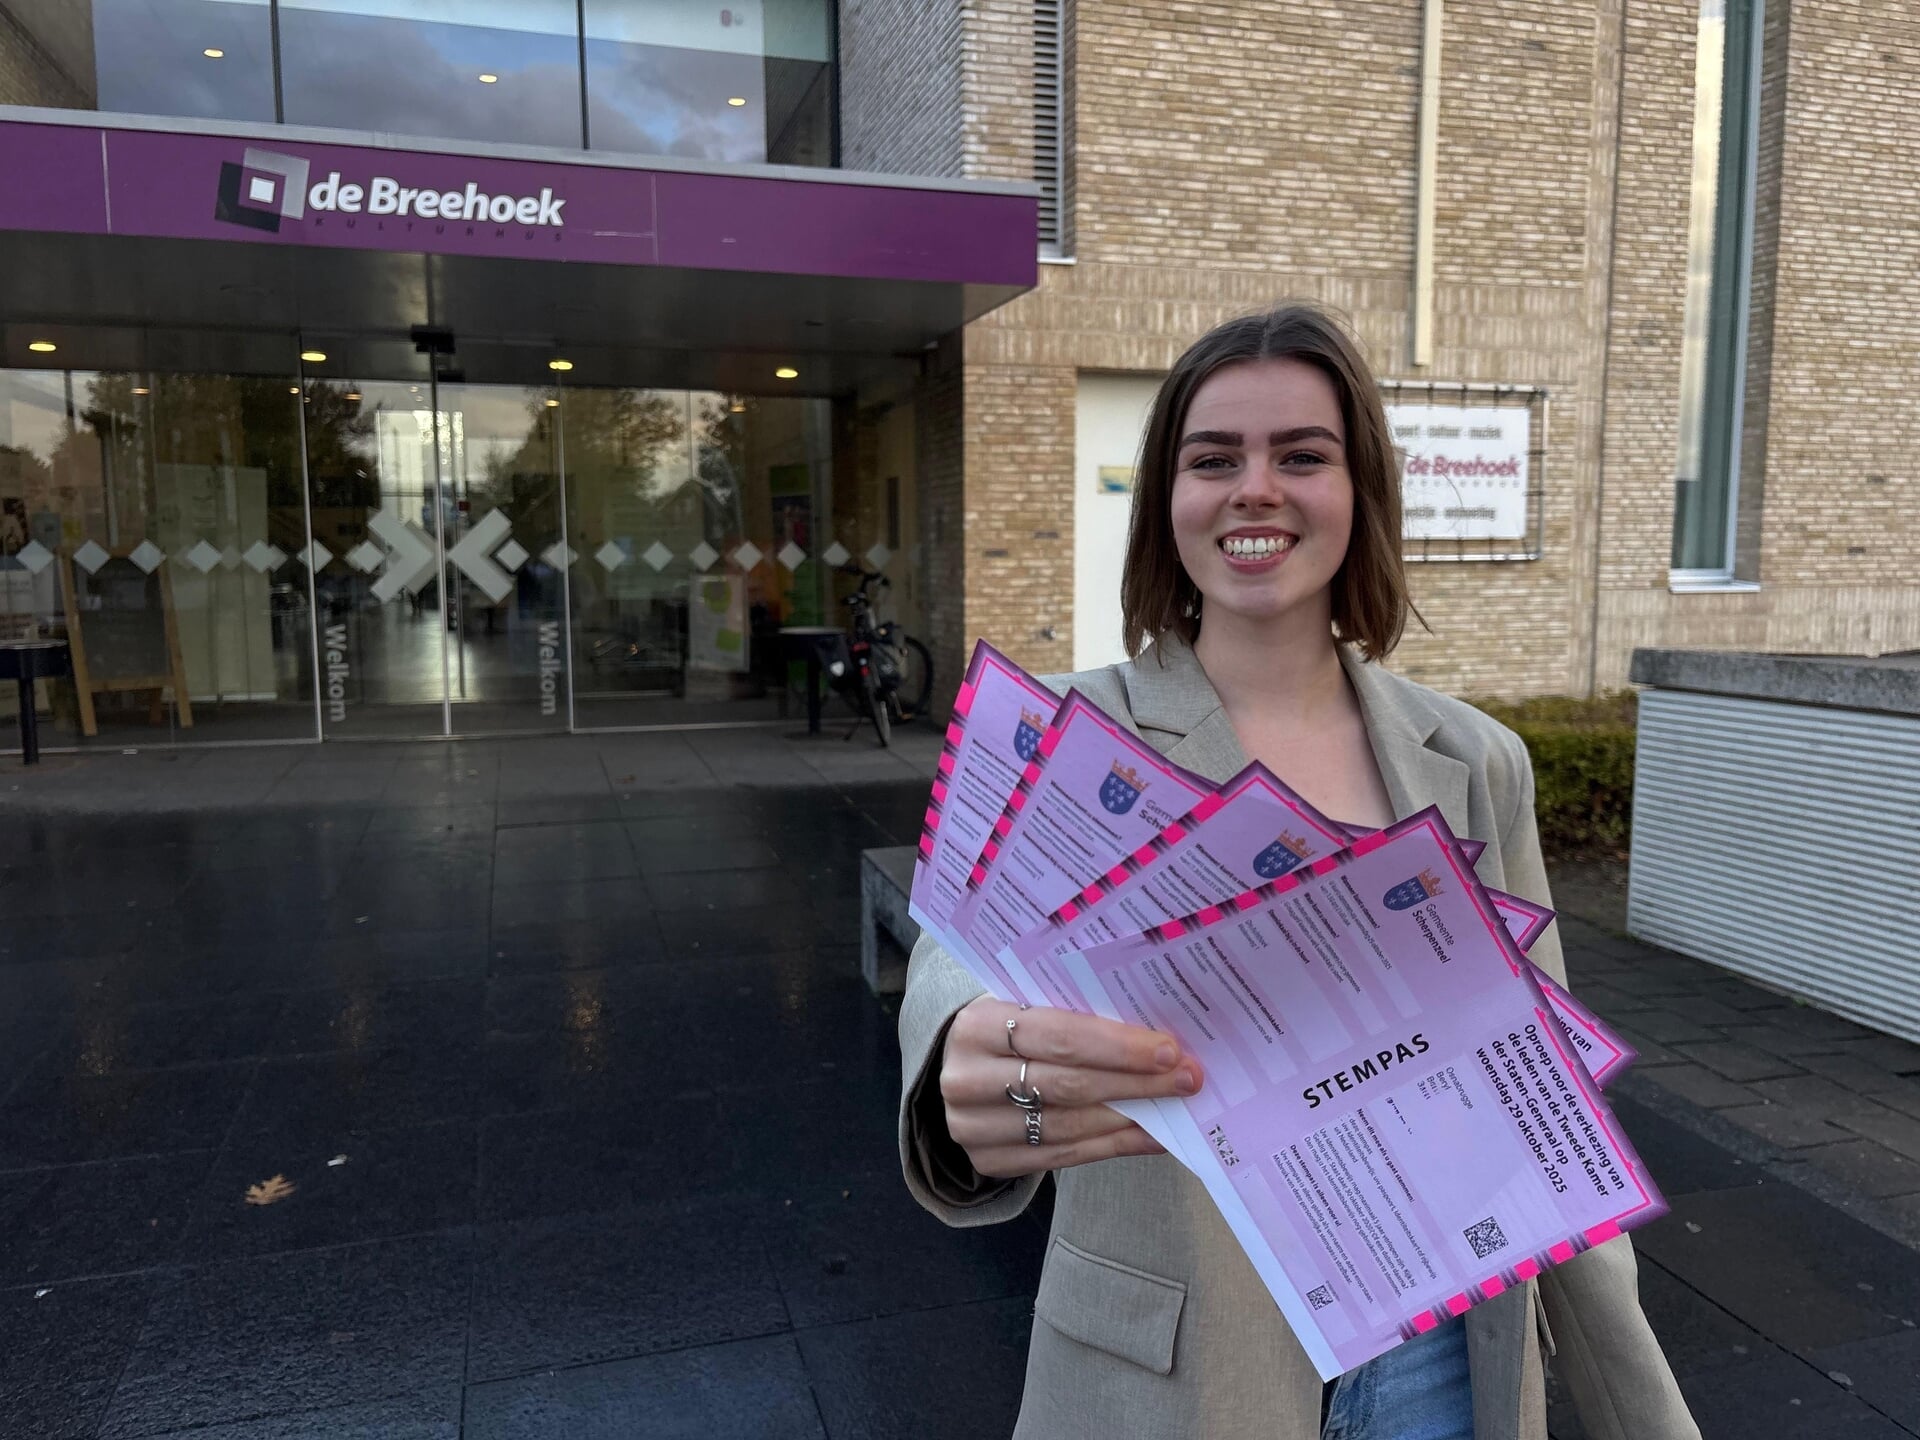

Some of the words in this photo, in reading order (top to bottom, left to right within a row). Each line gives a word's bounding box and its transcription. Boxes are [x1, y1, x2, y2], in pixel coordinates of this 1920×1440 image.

[309, 172, 363, 212] de
[368, 176, 566, 226] Breehoek
[1407, 453, 1429, 475] de
[1432, 455, 1519, 477] Breehoek
[325, 623, 349, 722] Welkom
[538, 620, 561, 716] Welkom
[1412, 910, 1451, 964] Scherpenzeel
[1426, 903, 1454, 946] Gemeente
[1303, 1033, 1430, 1109] STEMPAS
[1572, 1032, 1592, 1052] van
[1436, 1071, 1451, 1090] Beryl
[1446, 1067, 1473, 1109] Osnabrugge
[1492, 1041, 1508, 1059] der
[1503, 1059, 1562, 1149] Staten-Generaal
[1555, 1149, 1569, 1165] op
[1508, 1033, 1521, 1048] de
[1516, 1046, 1539, 1079] leden
[1535, 1078, 1551, 1101] van
[1548, 1101, 1560, 1116] de
[1557, 1114, 1586, 1159] Tweede
[1582, 1158, 1609, 1196] Kamer
[1524, 1024, 1552, 1066] Oproep
[1548, 1066, 1568, 1092] voor
[1563, 1093, 1576, 1108] de
[1573, 1108, 1611, 1168] verkiezing
[1608, 1167, 1624, 1190] van
[1357, 1108, 1369, 1126] Neem
[1367, 1126, 1375, 1135] dit
[1372, 1134, 1382, 1147] mee
[1379, 1147, 1387, 1156] als
[1386, 1161, 1398, 1174] gaat
[1476, 1048, 1513, 1105] woensdag
[1508, 1103, 1523, 1118] 29
[1518, 1120, 1549, 1163] oktober
[1544, 1163, 1567, 1193] 2025
[1290, 1144, 1301, 1160] Deze
[1299, 1160, 1316, 1184] stempas
[1316, 1189, 1329, 1207] alleen
[1327, 1206, 1337, 1220] voor
